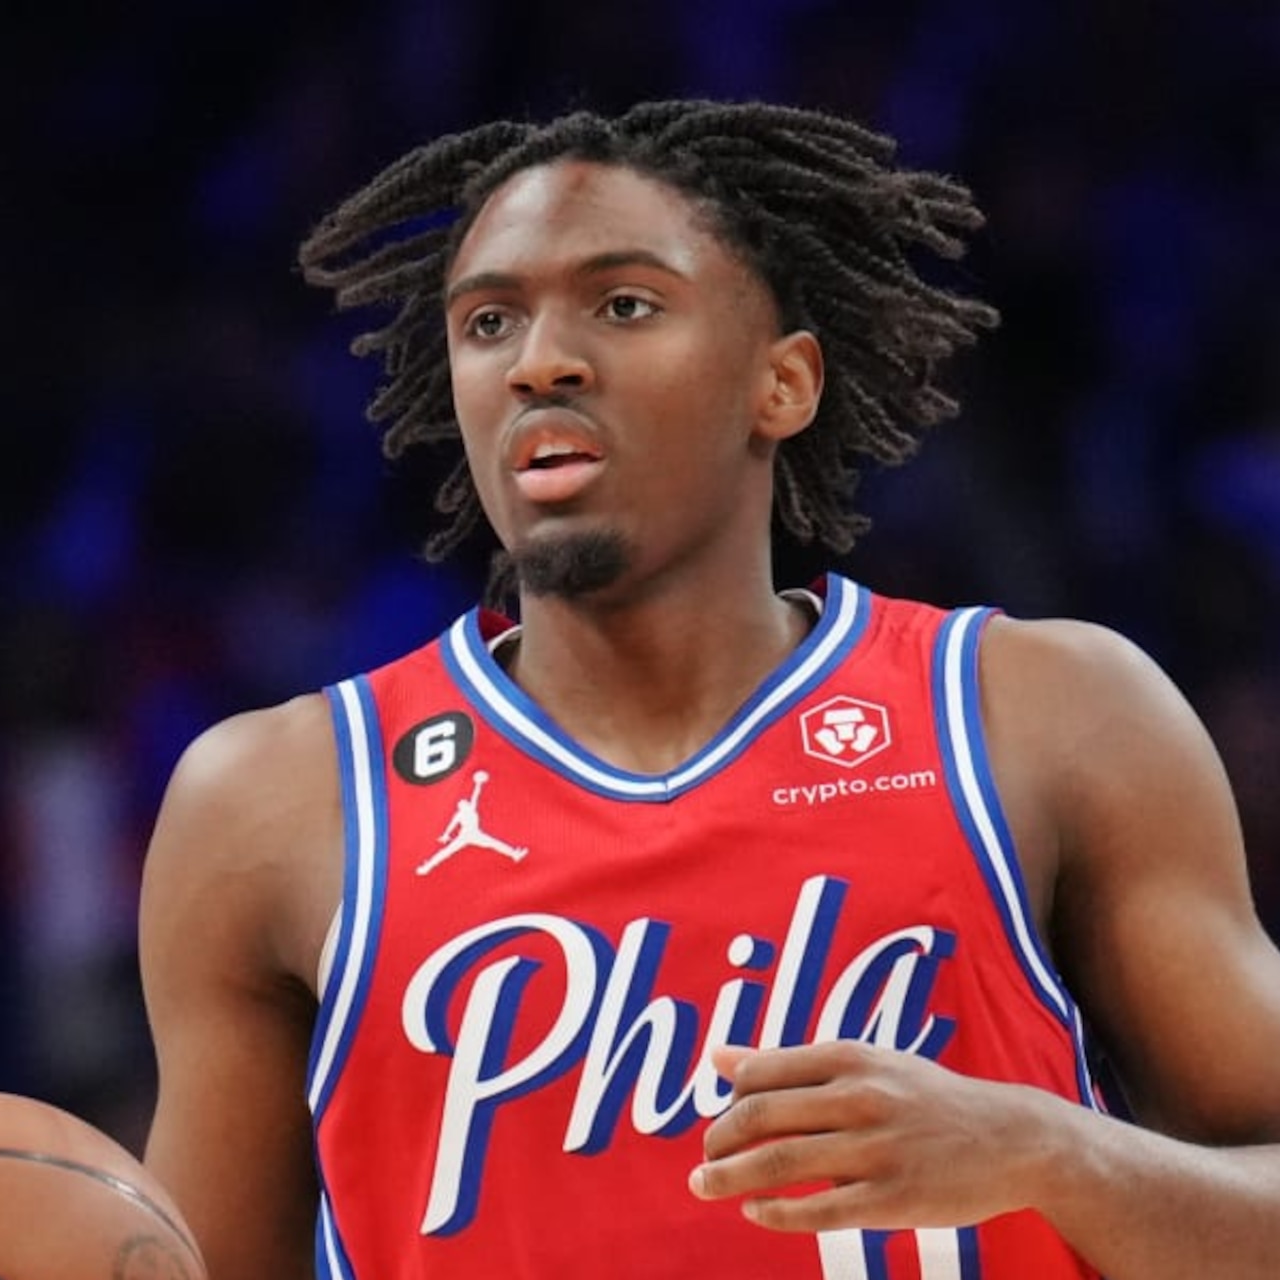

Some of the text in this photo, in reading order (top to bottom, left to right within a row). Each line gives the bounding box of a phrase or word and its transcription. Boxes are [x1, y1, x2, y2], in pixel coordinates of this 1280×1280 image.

[414, 720, 456, 778] 6
[772, 770, 936, 805] crypto.com
[402, 875, 958, 1239] Phila
